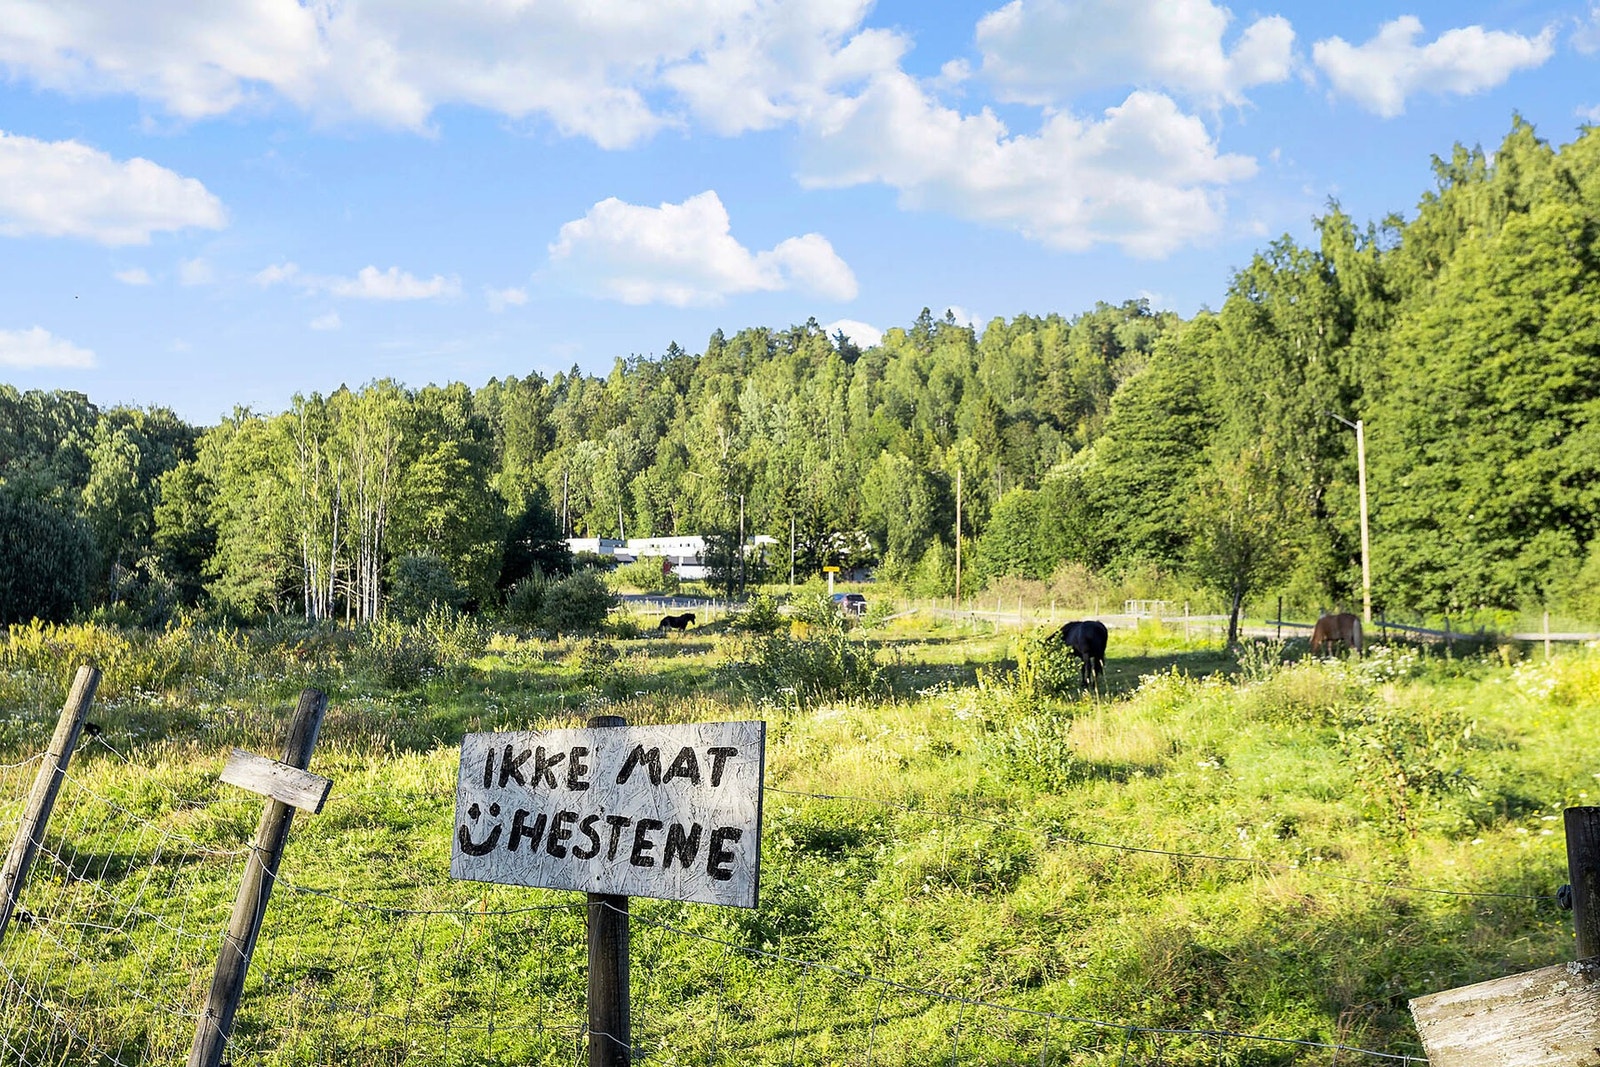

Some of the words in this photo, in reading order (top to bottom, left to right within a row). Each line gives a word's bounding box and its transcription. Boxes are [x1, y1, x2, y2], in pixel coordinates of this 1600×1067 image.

[483, 744, 589, 791] IKKE
[616, 744, 739, 787] MAT
[507, 808, 743, 881] HESTENE
